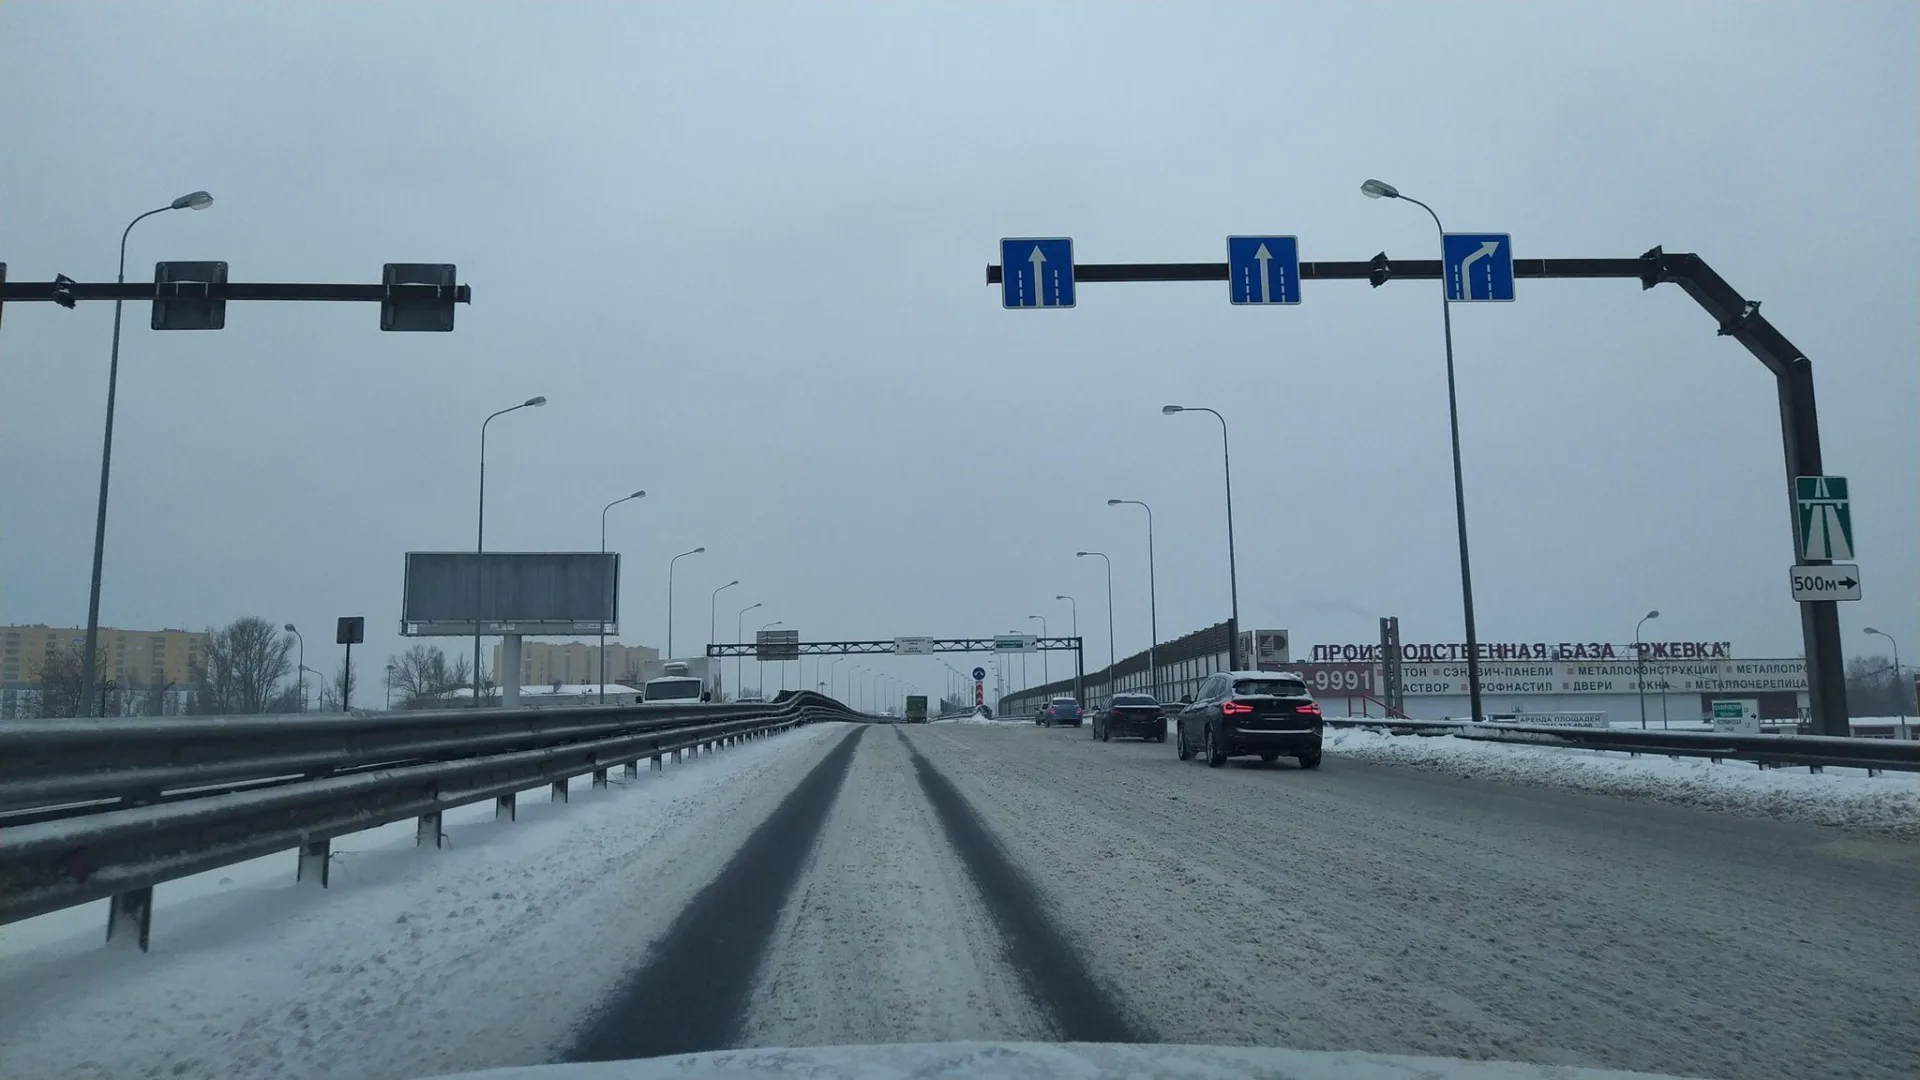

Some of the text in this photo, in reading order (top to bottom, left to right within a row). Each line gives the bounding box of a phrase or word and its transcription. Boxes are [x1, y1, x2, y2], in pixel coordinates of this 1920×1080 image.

[1559, 643, 1615, 660] БАЗА
[1443, 667, 1553, 678] СЭНВИЧ-ПАНЕЛИ
[1578, 665, 1718, 675] МЕТАЛЛОКОНСТРУКЦИИ
[1480, 682, 1553, 692] РОФНАСТИЛ
[1573, 681, 1612, 691] ДВЕРИ
[1638, 680, 1671, 690] ОКНА
[1695, 679, 1808, 690] МЕТАЛЛОЧЕРЕПИЦА
